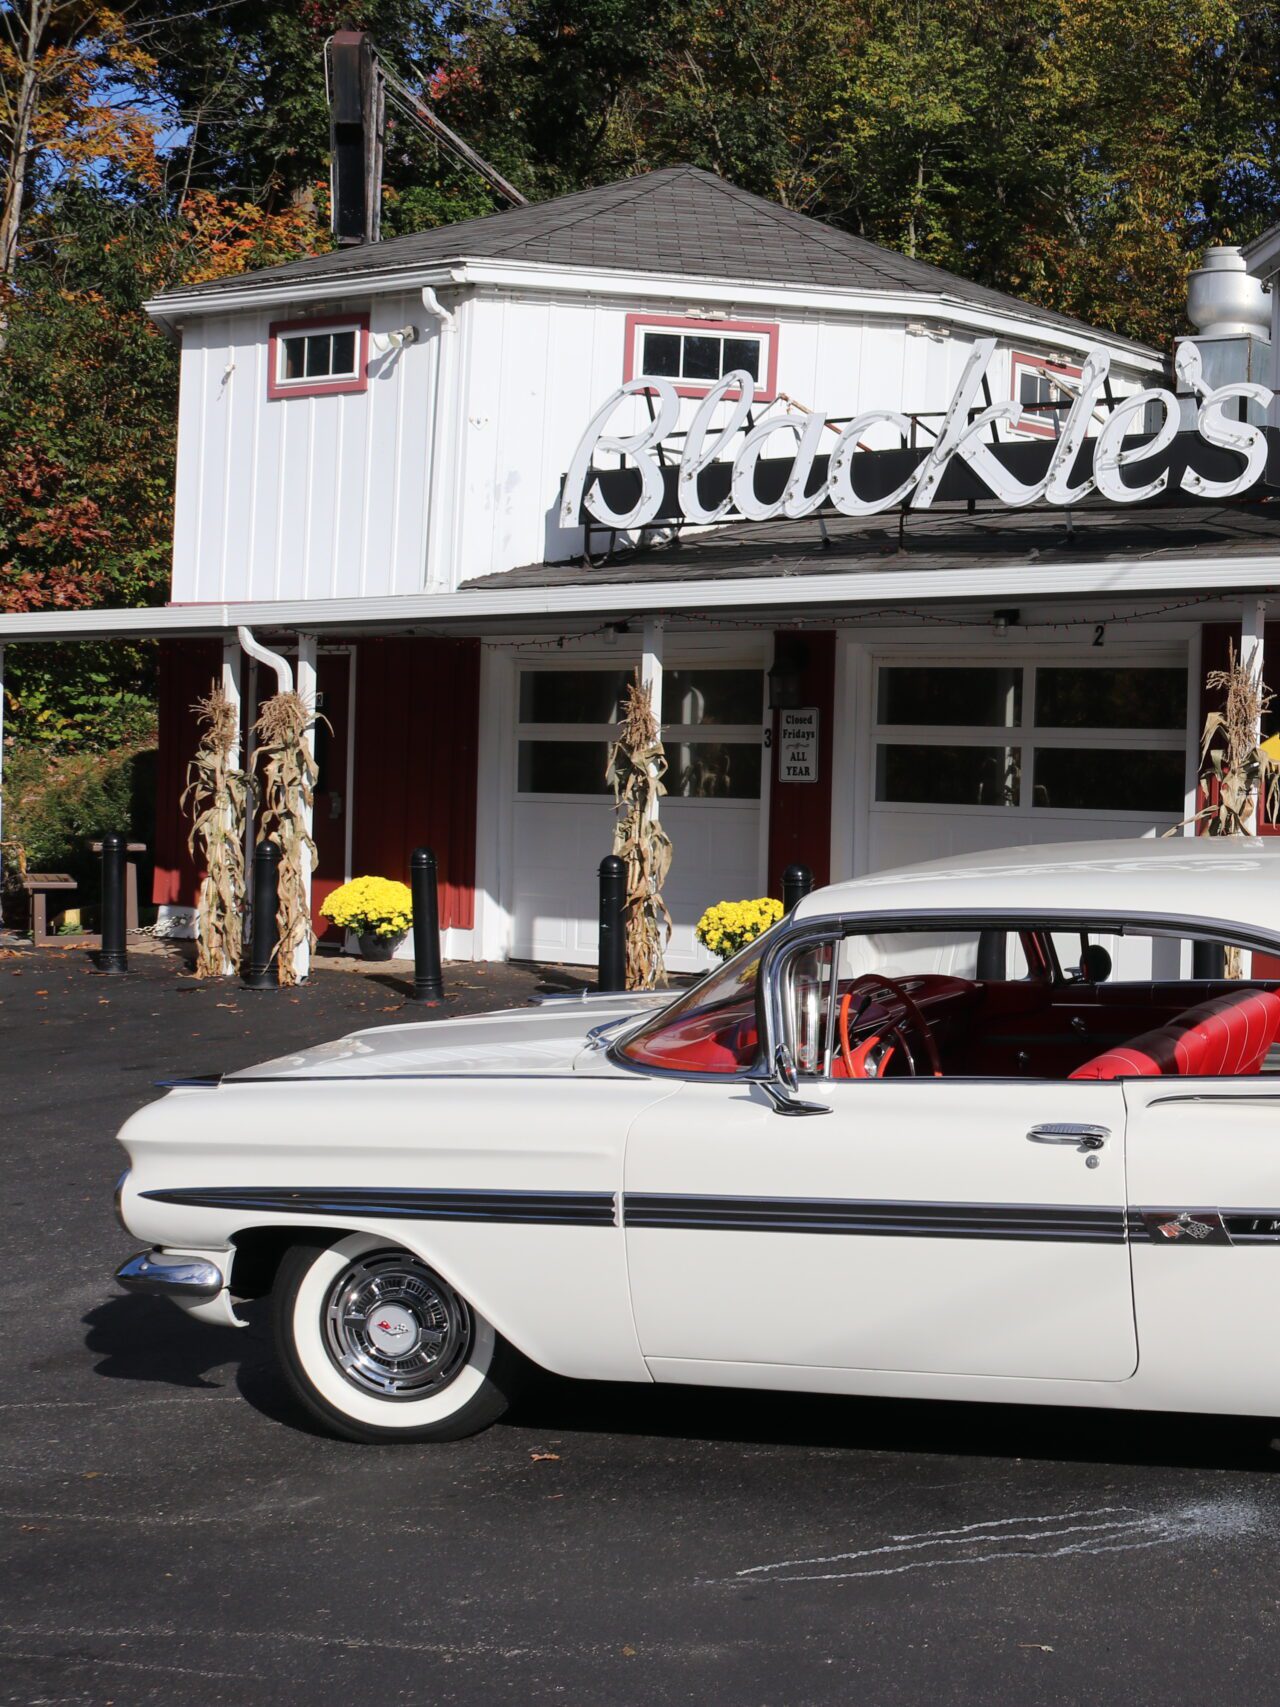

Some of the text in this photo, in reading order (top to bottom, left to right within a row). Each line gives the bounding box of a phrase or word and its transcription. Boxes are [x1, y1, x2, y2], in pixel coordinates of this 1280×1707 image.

[559, 338, 1272, 528] Blackie's
[1092, 625, 1104, 646] 2
[785, 715, 813, 725] Closed
[764, 728, 772, 748] 3
[782, 729, 815, 740] Fridays
[790, 752, 807, 761] ALL
[786, 766, 810, 776] YEAR
